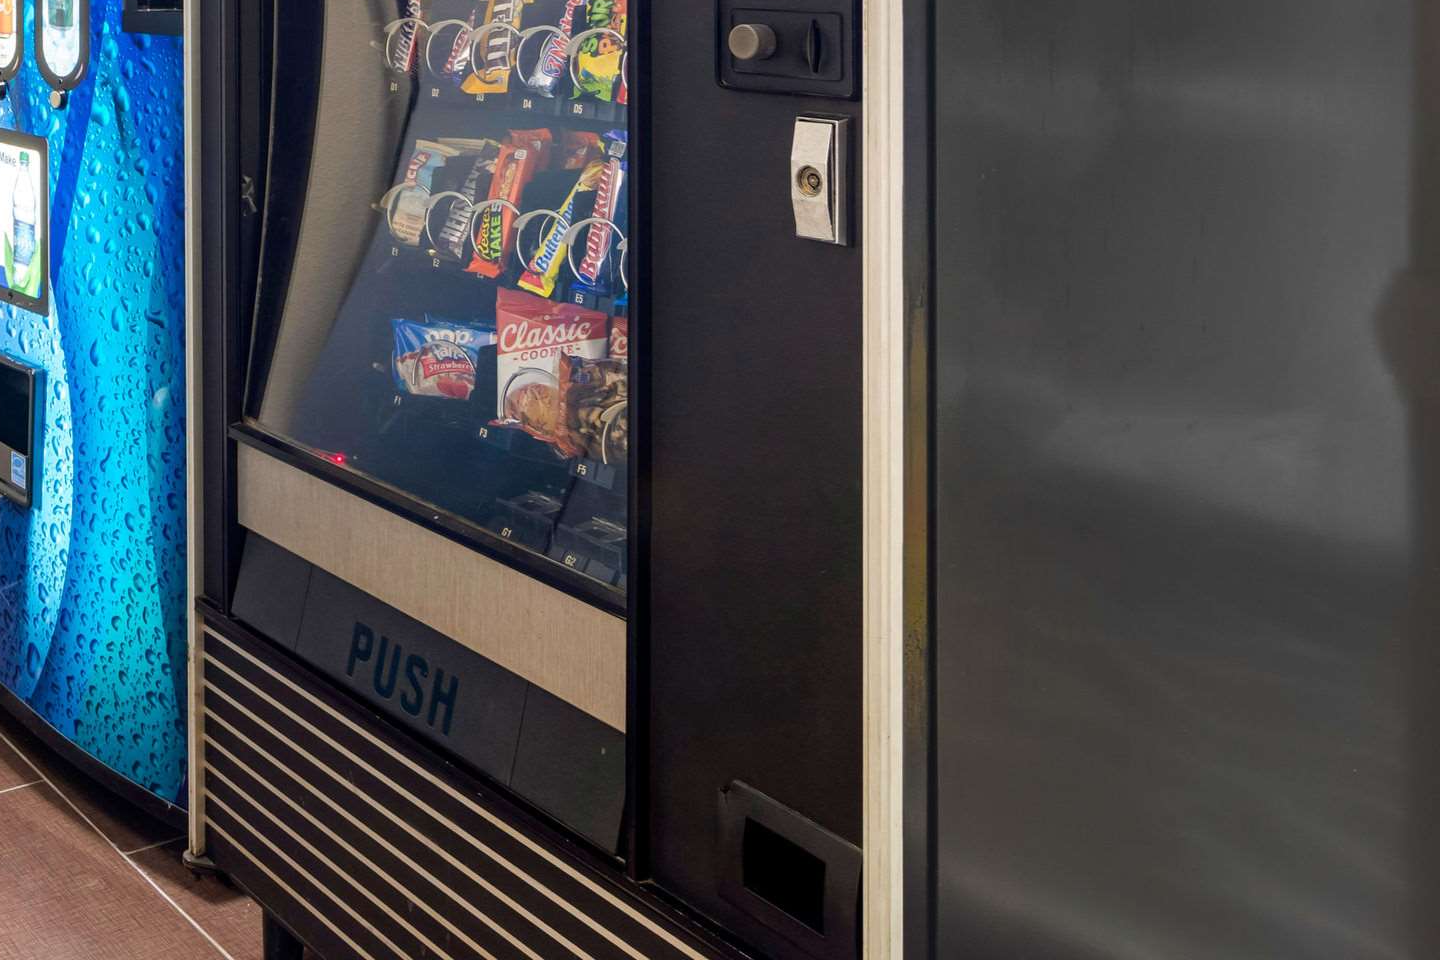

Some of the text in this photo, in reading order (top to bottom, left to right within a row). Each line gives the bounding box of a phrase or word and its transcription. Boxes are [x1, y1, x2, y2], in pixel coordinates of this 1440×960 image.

[523, 99, 532, 109] D4
[574, 104, 583, 114] D5
[0, 150, 17, 167] Make
[490, 214, 502, 259] TAKE
[500, 314, 592, 352] Classic
[479, 428, 488, 439] F3
[501, 527, 512, 538] G1
[565, 555, 576, 566] G2
[346, 621, 459, 736] PUSH
